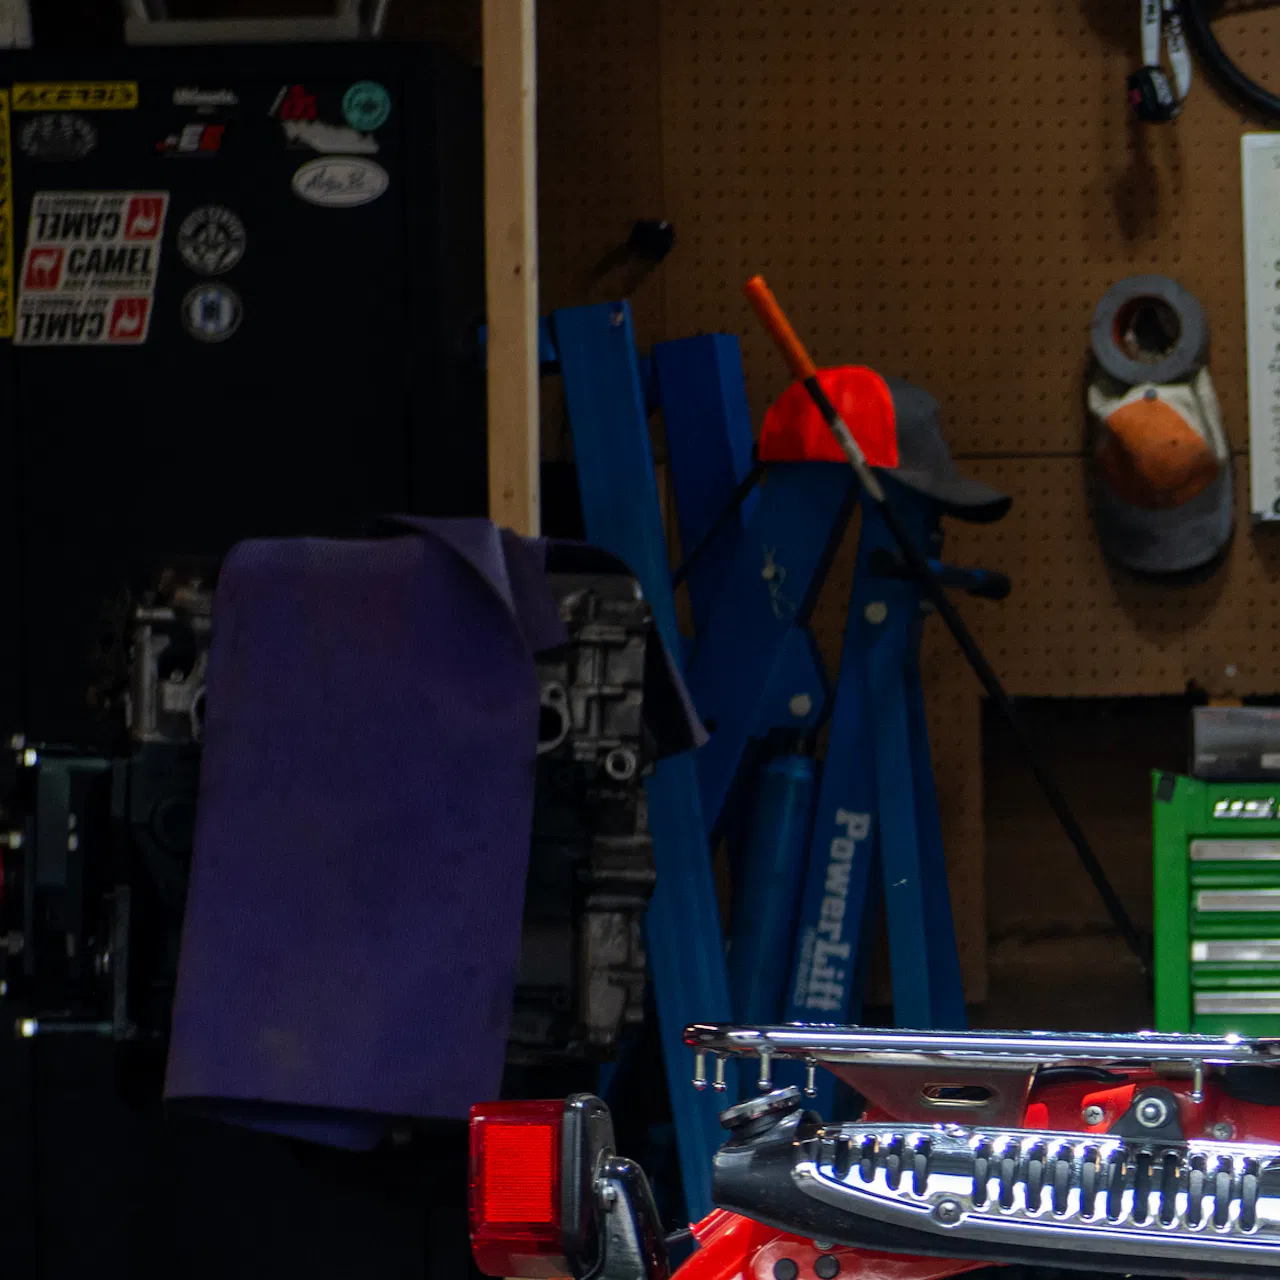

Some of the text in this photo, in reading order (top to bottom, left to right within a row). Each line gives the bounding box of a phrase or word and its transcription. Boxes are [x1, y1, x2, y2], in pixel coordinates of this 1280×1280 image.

[36, 211, 121, 242] CAMEL
[67, 248, 154, 276] CAMEL
[21, 312, 105, 344] CAMEL
[805, 807, 872, 1011] PowerLift
